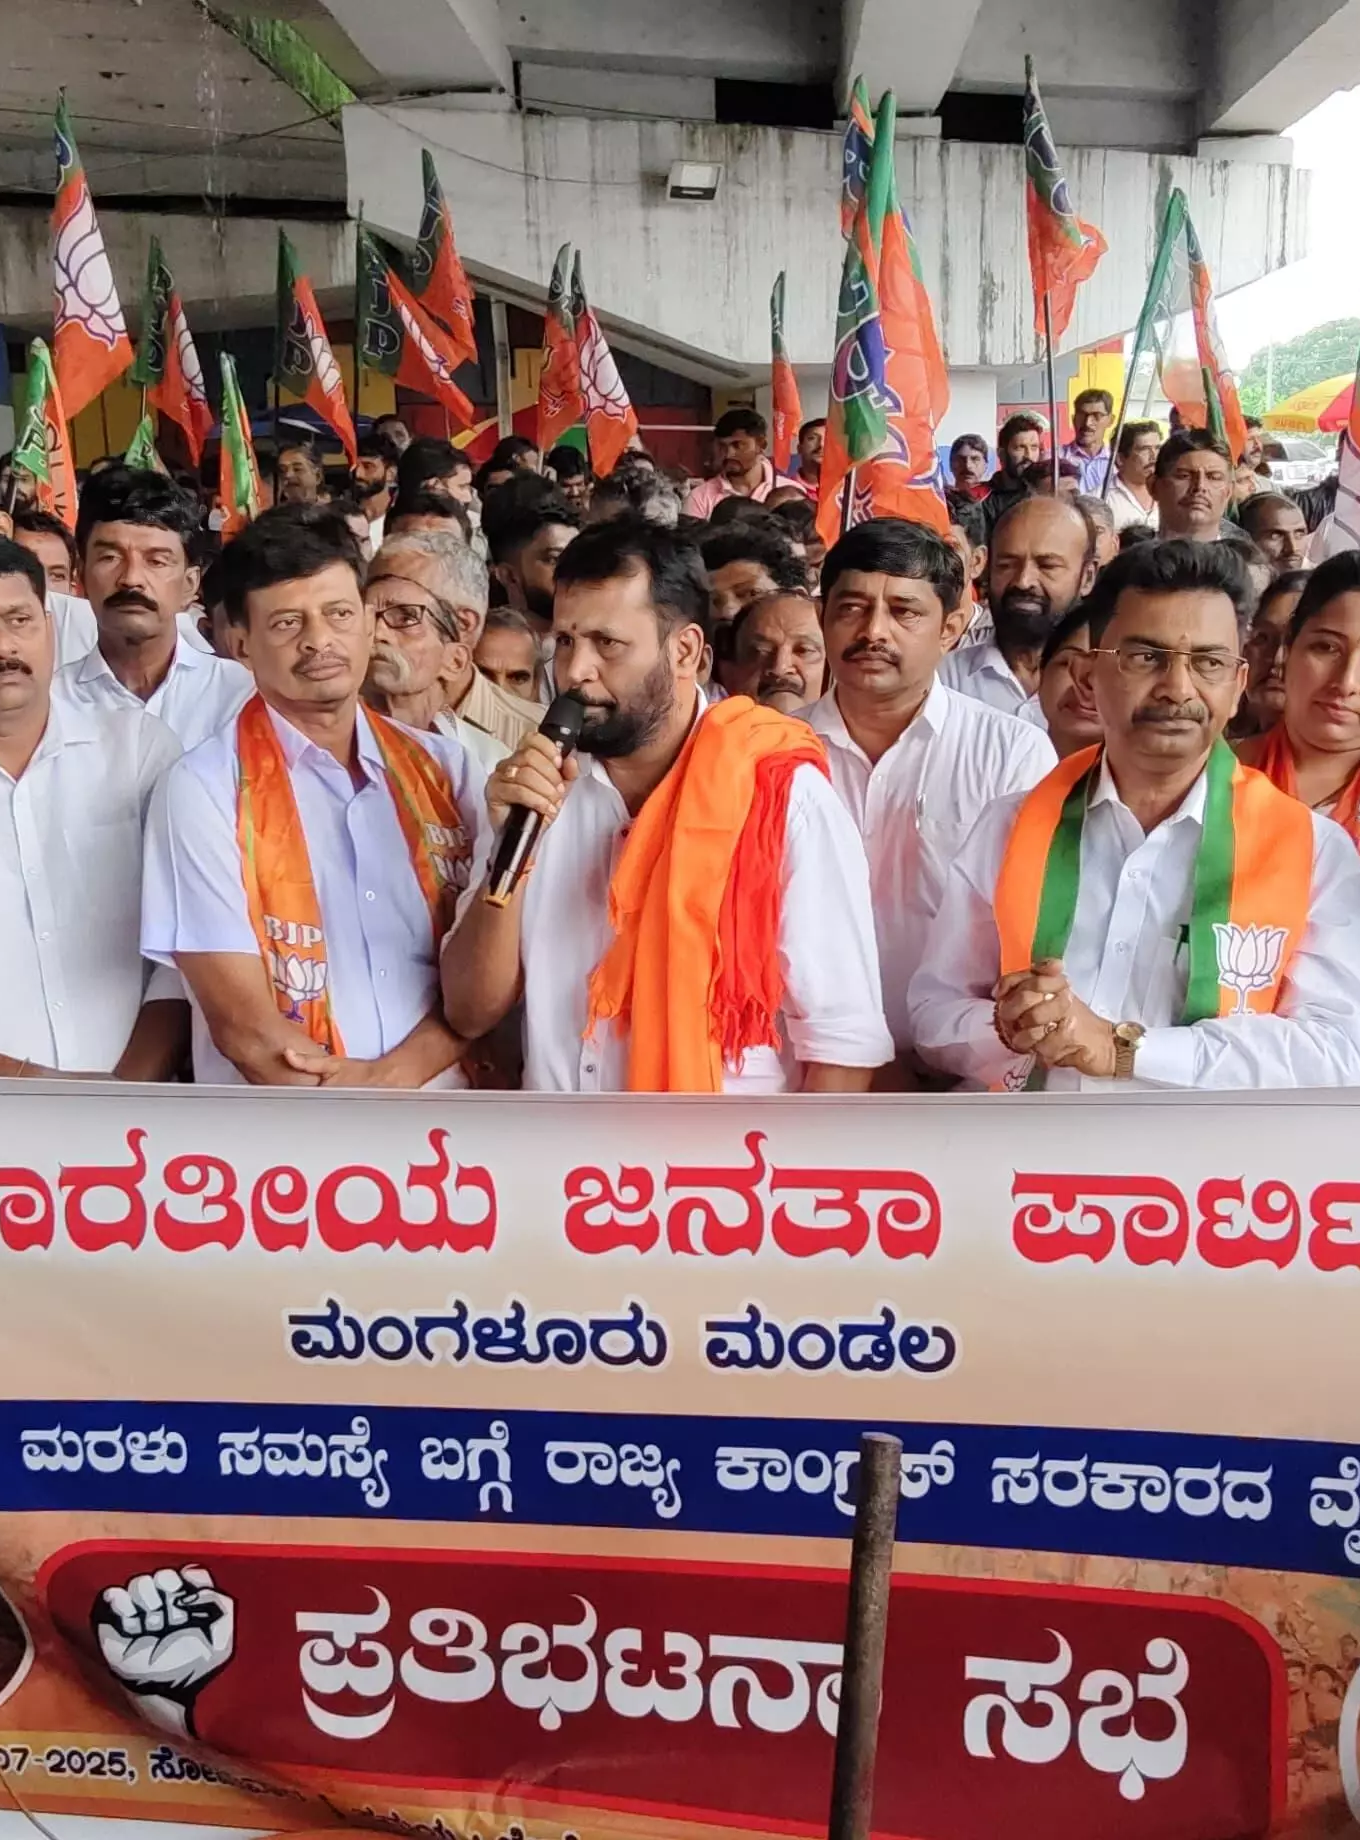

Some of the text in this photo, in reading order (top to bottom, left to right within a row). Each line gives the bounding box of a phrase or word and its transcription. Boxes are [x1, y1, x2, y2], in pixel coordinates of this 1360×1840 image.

[263, 914, 324, 949] BJP
[563, 1130, 942, 1262] ಜನತಾ
[288, 1299, 957, 1373] ಮಂಗಳೂರು ಮಂಡಲ
[20, 1422, 189, 1475] ಮರಳು
[217, 1415, 391, 1509] ಸಮಸ್ಯೆ
[420, 1420, 514, 1513] ಬಗ್ಗೆ
[544, 1440, 683, 1519] ರಾಜ್ಯ
[991, 1450, 1273, 1521] ಸರಕಾರದ
[963, 1627, 1190, 1801] ಸಭೆ
